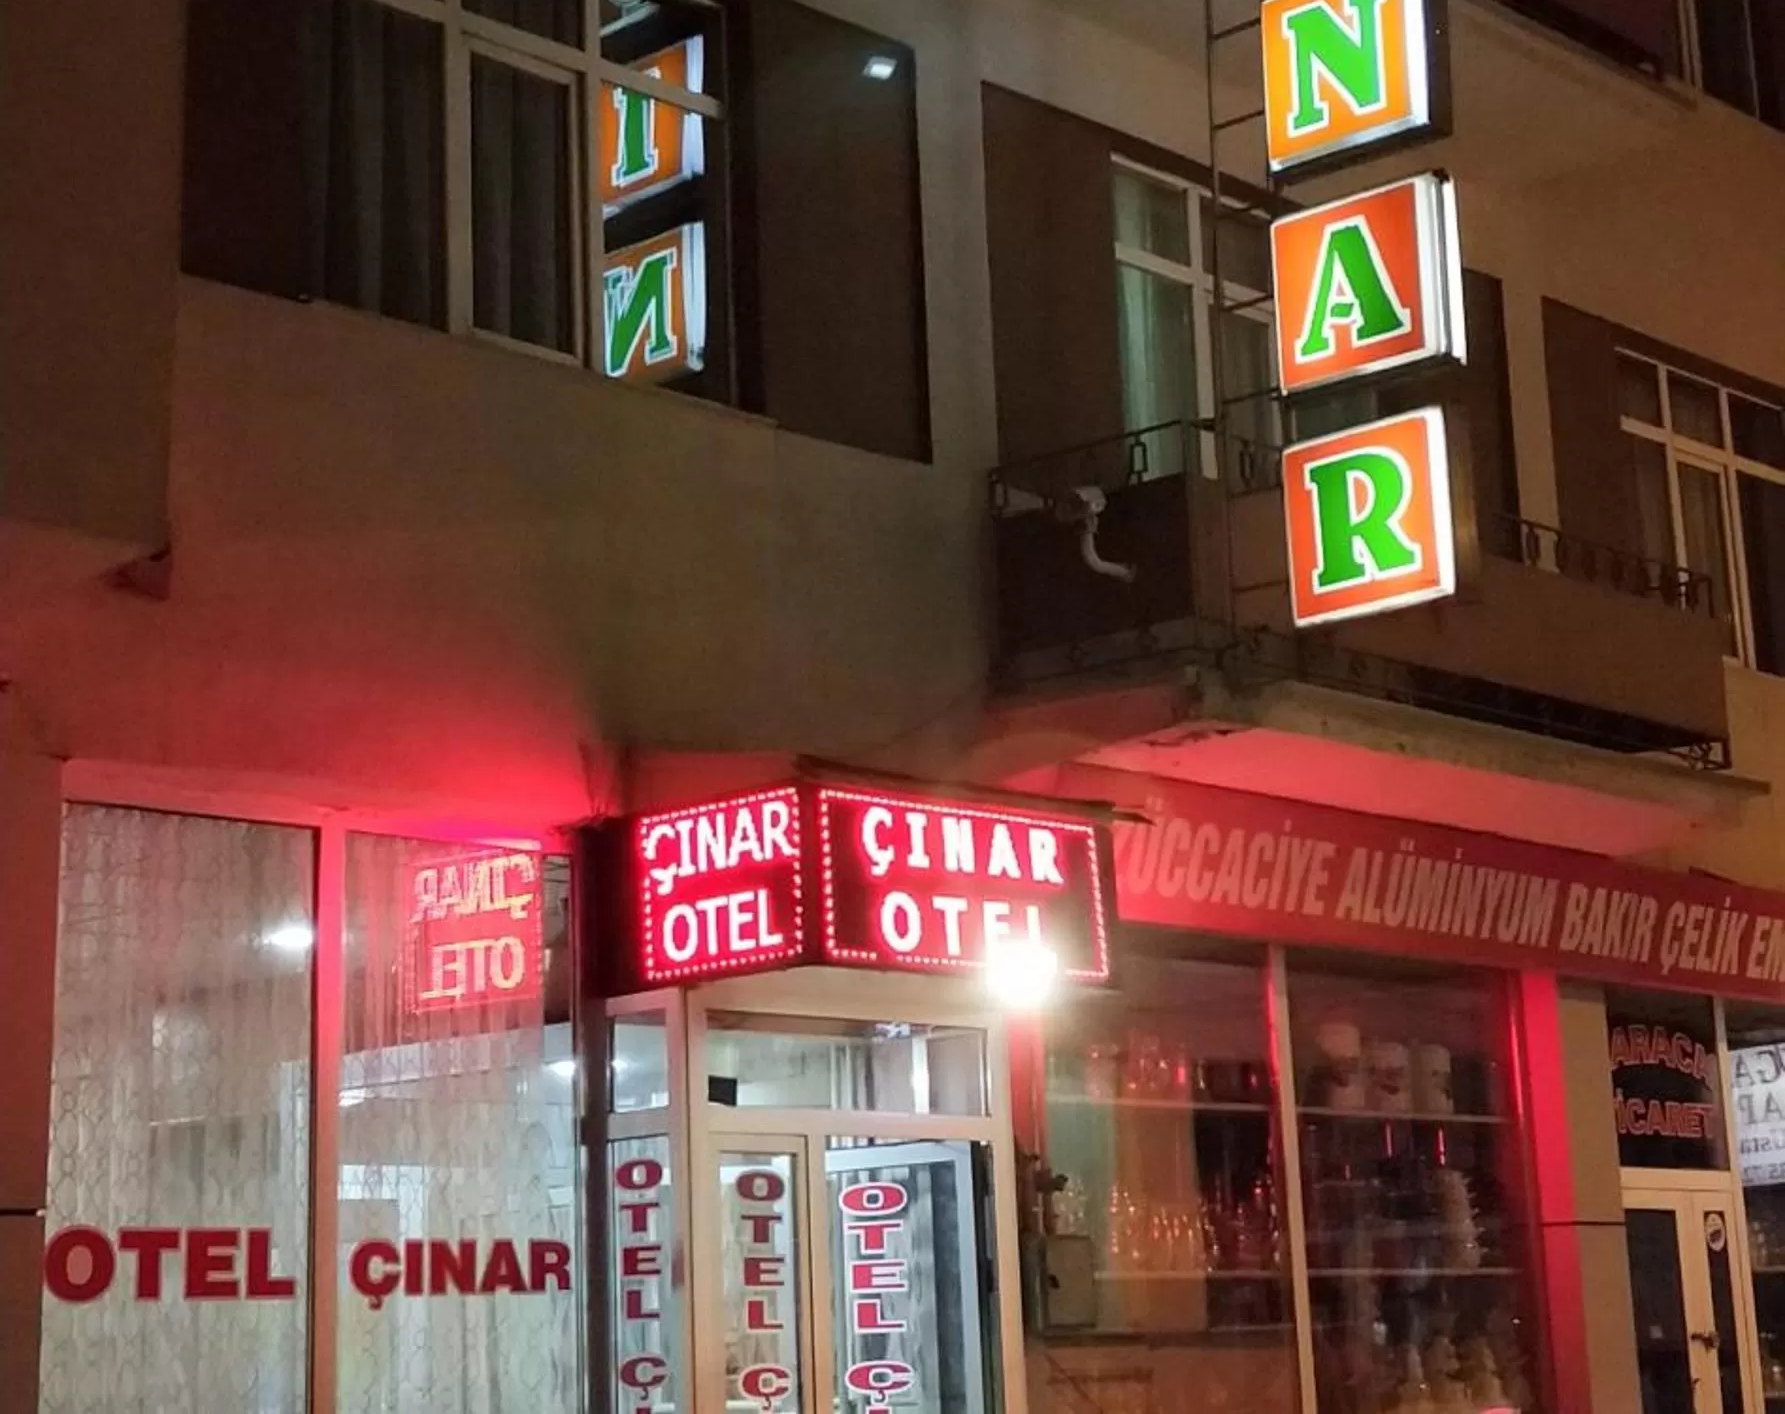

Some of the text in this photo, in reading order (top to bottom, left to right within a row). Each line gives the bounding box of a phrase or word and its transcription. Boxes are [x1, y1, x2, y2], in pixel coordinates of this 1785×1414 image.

[645, 801, 796, 894] ÇINAR
[862, 806, 1064, 885] ÇINAR
[663, 889, 783, 962] OTEL
[1335, 838, 1560, 948] ALÜMİNYUM
[1560, 882, 1658, 963] BAKIR
[1660, 896, 1748, 975] ÇELİK
[1612, 1088, 1716, 1138] İCARET
[44, 1226, 572, 1310] OTEL ÇINAR
[615, 1159, 667, 1414] OTEL Ç
[735, 1170, 785, 1331] OTEL
[839, 1182, 914, 1414] OTEL Ç
